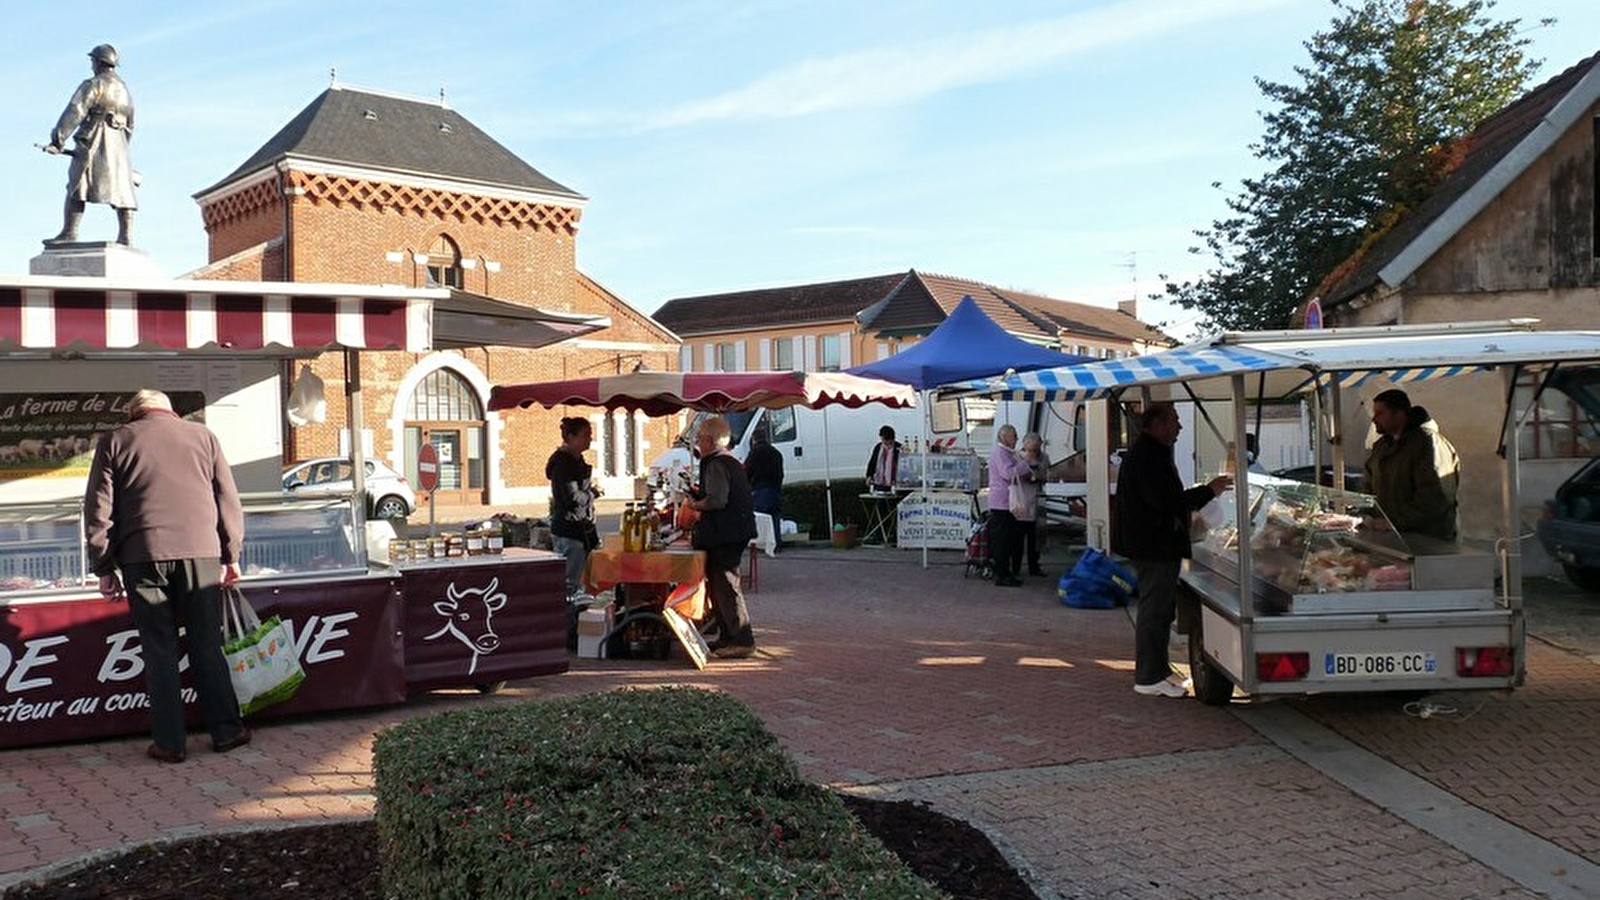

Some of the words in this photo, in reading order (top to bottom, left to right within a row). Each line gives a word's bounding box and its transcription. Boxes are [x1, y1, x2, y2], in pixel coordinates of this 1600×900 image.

[0, 405, 15, 419] a
[21, 398, 79, 416] ferme
[82, 394, 105, 412] de
[931, 528, 964, 536] DIRECTE
[1337, 655, 1423, 674] BD-086-CC
[67, 696, 101, 715] au
